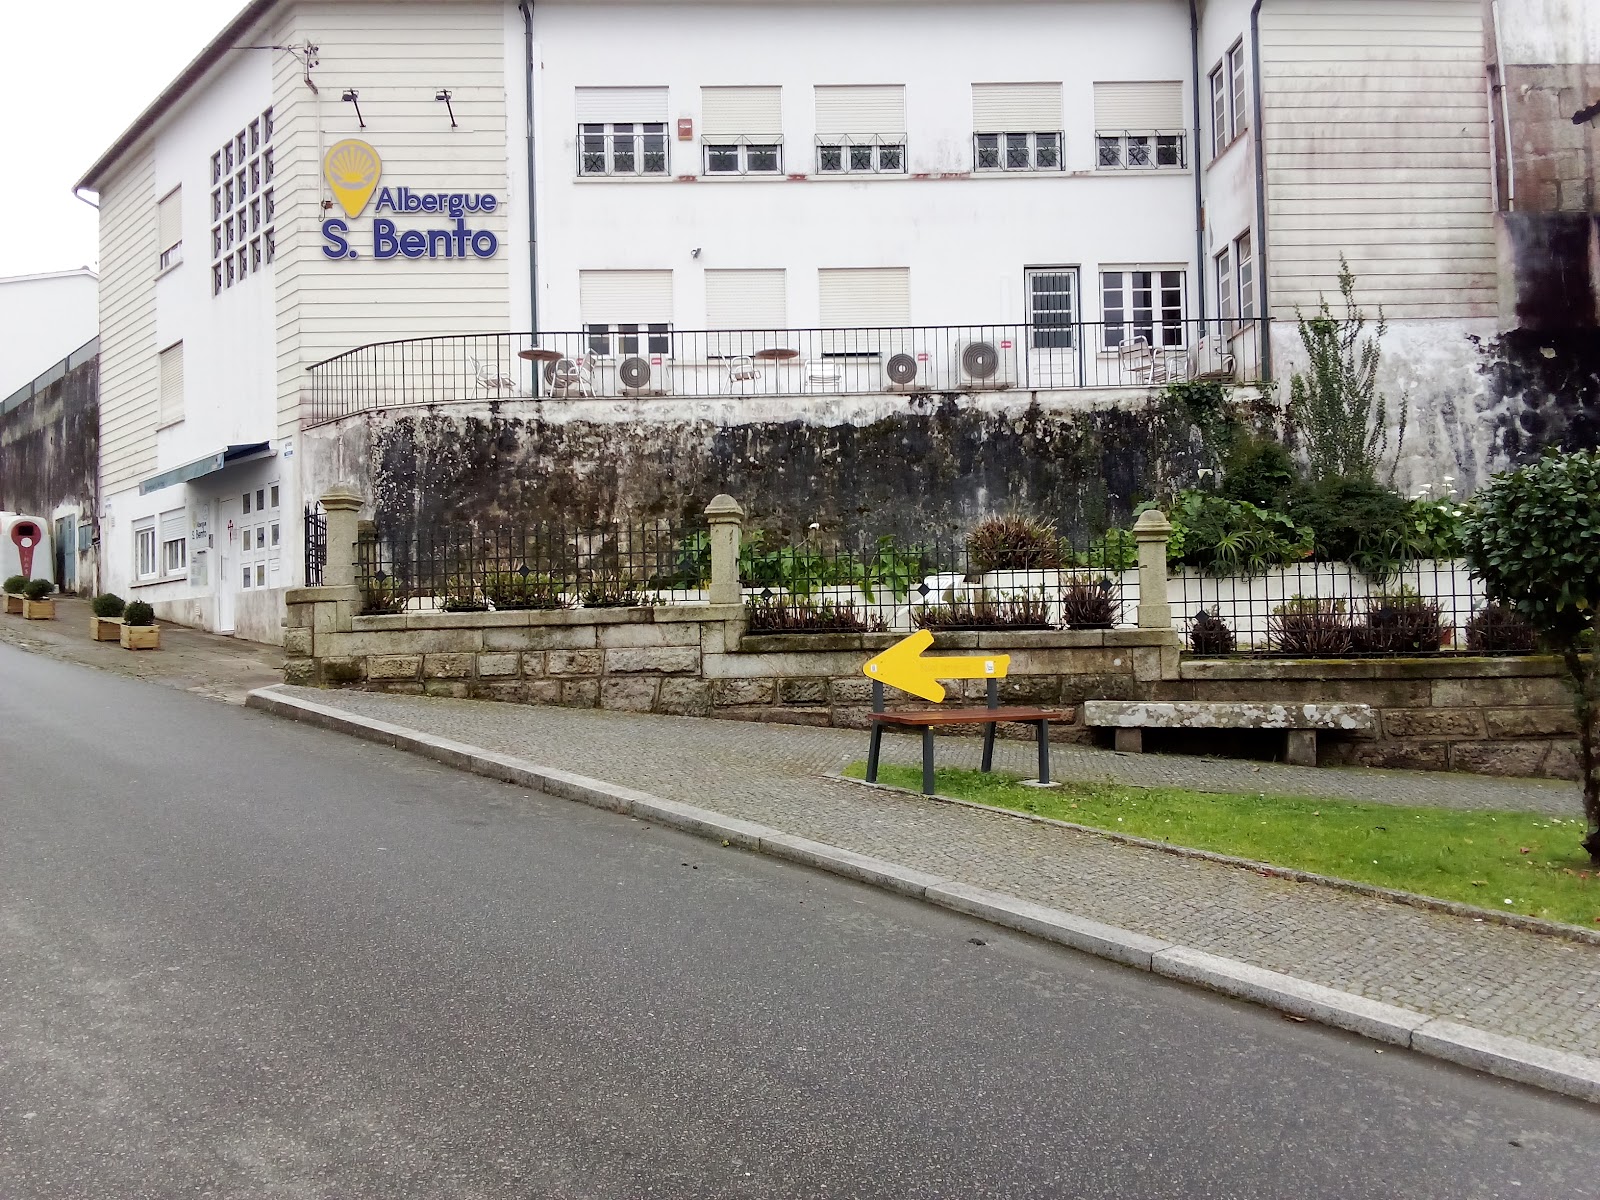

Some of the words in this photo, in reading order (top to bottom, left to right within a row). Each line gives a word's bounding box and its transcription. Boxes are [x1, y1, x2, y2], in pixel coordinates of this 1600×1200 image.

[375, 186, 498, 218] Albergue
[322, 218, 358, 260] S.
[373, 218, 499, 260] Bento
